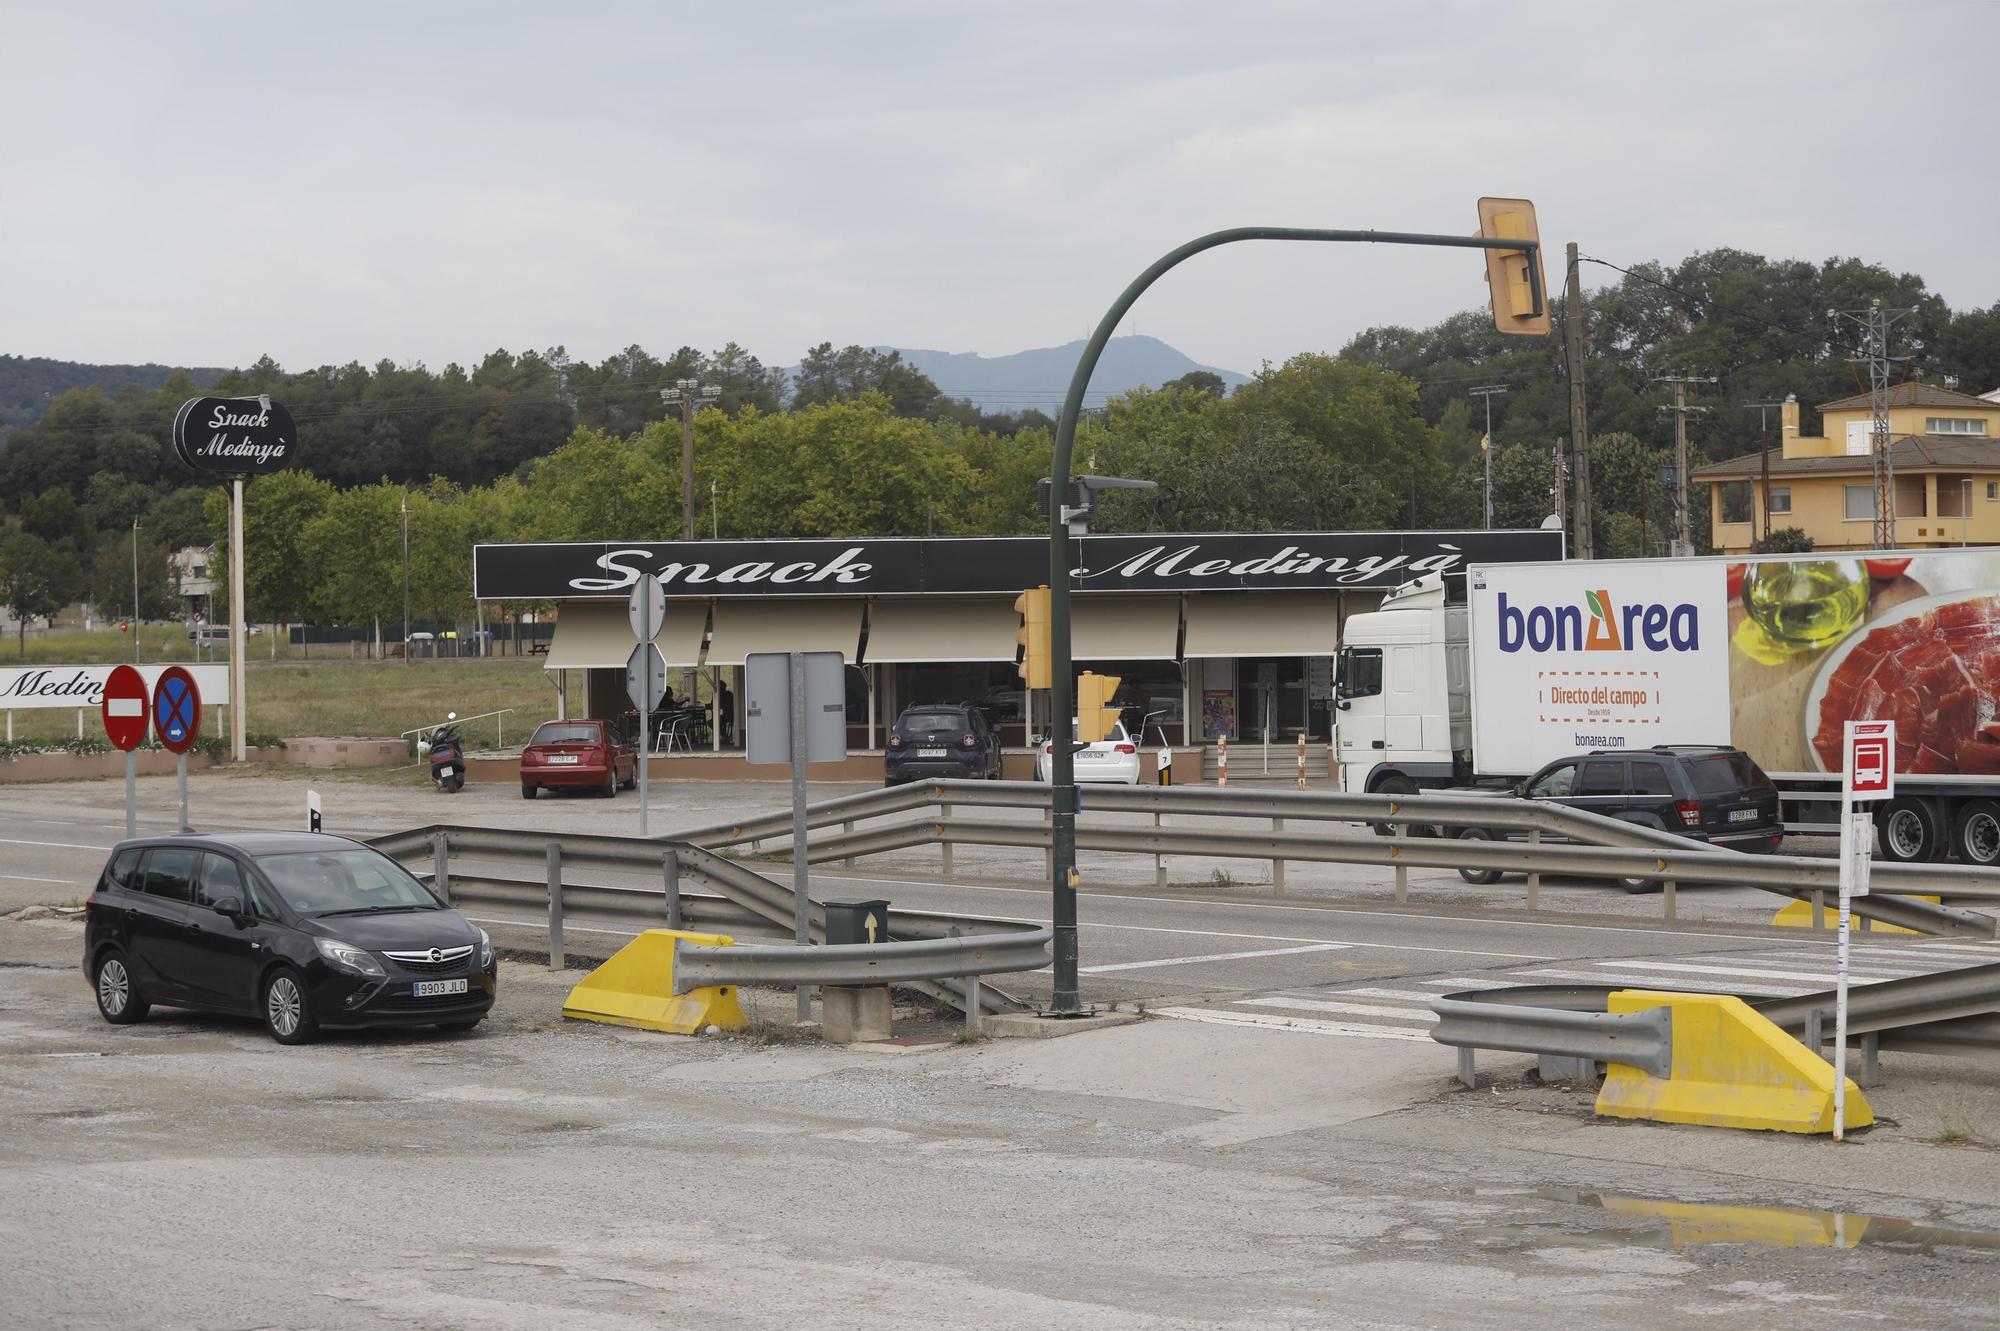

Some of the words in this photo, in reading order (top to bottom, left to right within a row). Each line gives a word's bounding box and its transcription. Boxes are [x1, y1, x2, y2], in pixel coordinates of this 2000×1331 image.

[208, 406, 268, 428] Snack
[196, 433, 285, 464] Medinyà
[569, 548, 872, 590] Snack
[1069, 544, 1463, 583] Medinyà
[0, 671, 104, 705] Medin
[1551, 686, 1589, 704] Directo
[1591, 686, 1608, 704] del
[1610, 690, 1647, 708] campo
[1587, 708, 1600, 716] Desde
[1575, 732, 1625, 747] bonarea.com
[421, 983, 445, 994] 9903
[449, 981, 466, 992] JLD
